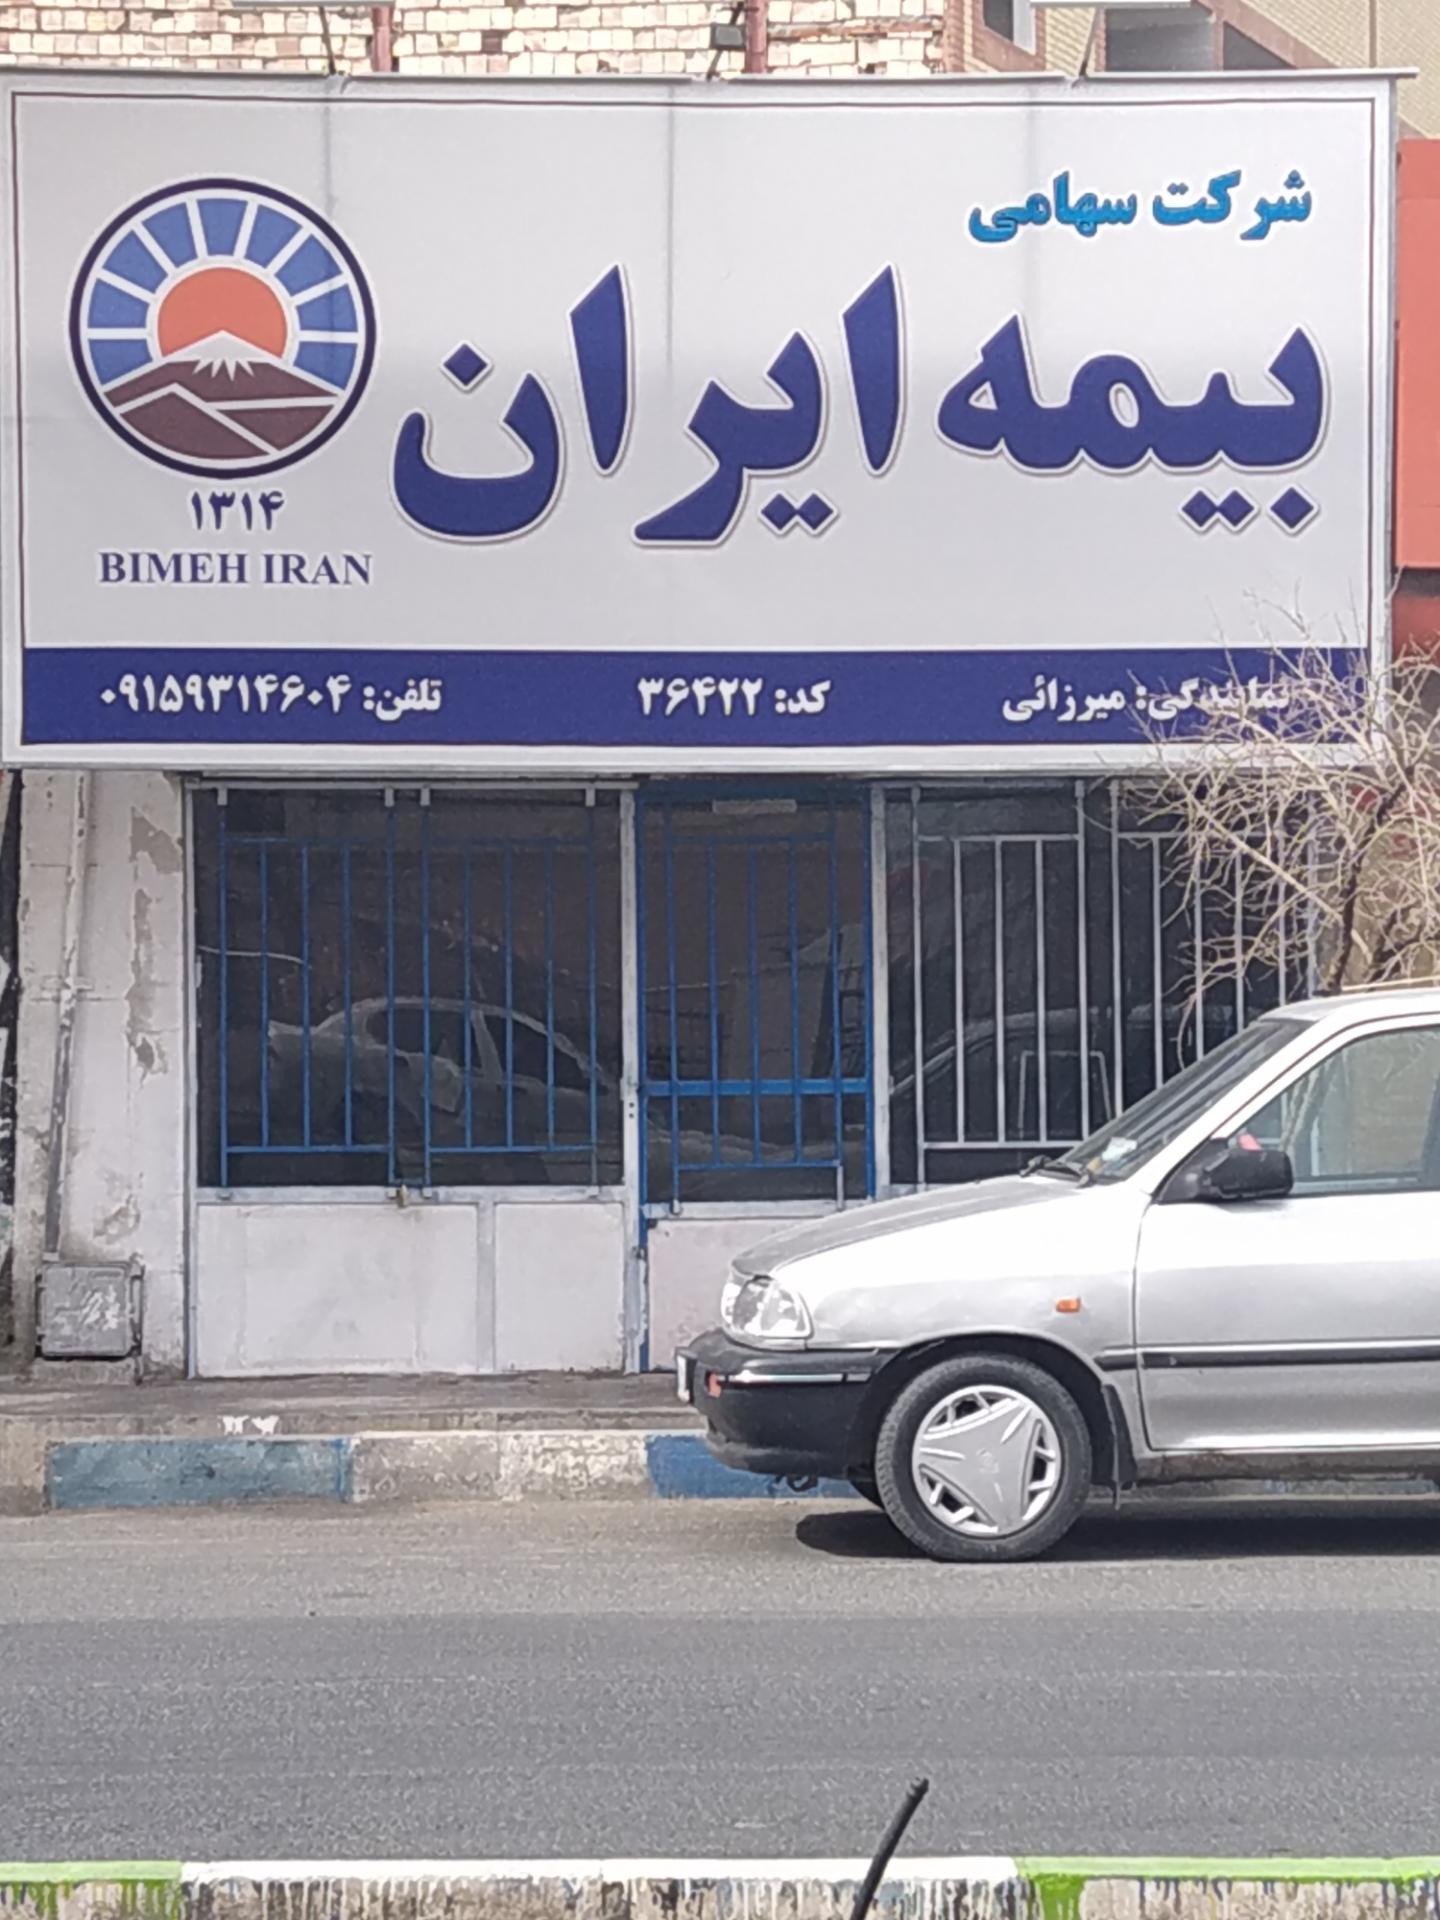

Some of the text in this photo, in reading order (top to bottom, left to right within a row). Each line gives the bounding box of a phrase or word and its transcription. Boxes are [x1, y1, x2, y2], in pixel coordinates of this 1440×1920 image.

[968, 169, 1312, 243] شرکت سهامی
[394, 265, 1326, 541] بیمه ایران
[191, 491, 285, 531] ۱۳۱۴
[99, 551, 373, 585] BIMEH IRAN
[100, 674, 442, 721] تلفن: ۰۹۱۵۹۳۱۴۶۰۴
[638, 676, 831, 716] کد: ۳۶۴۲۲
[1002, 674, 1127, 722] میرزائی
